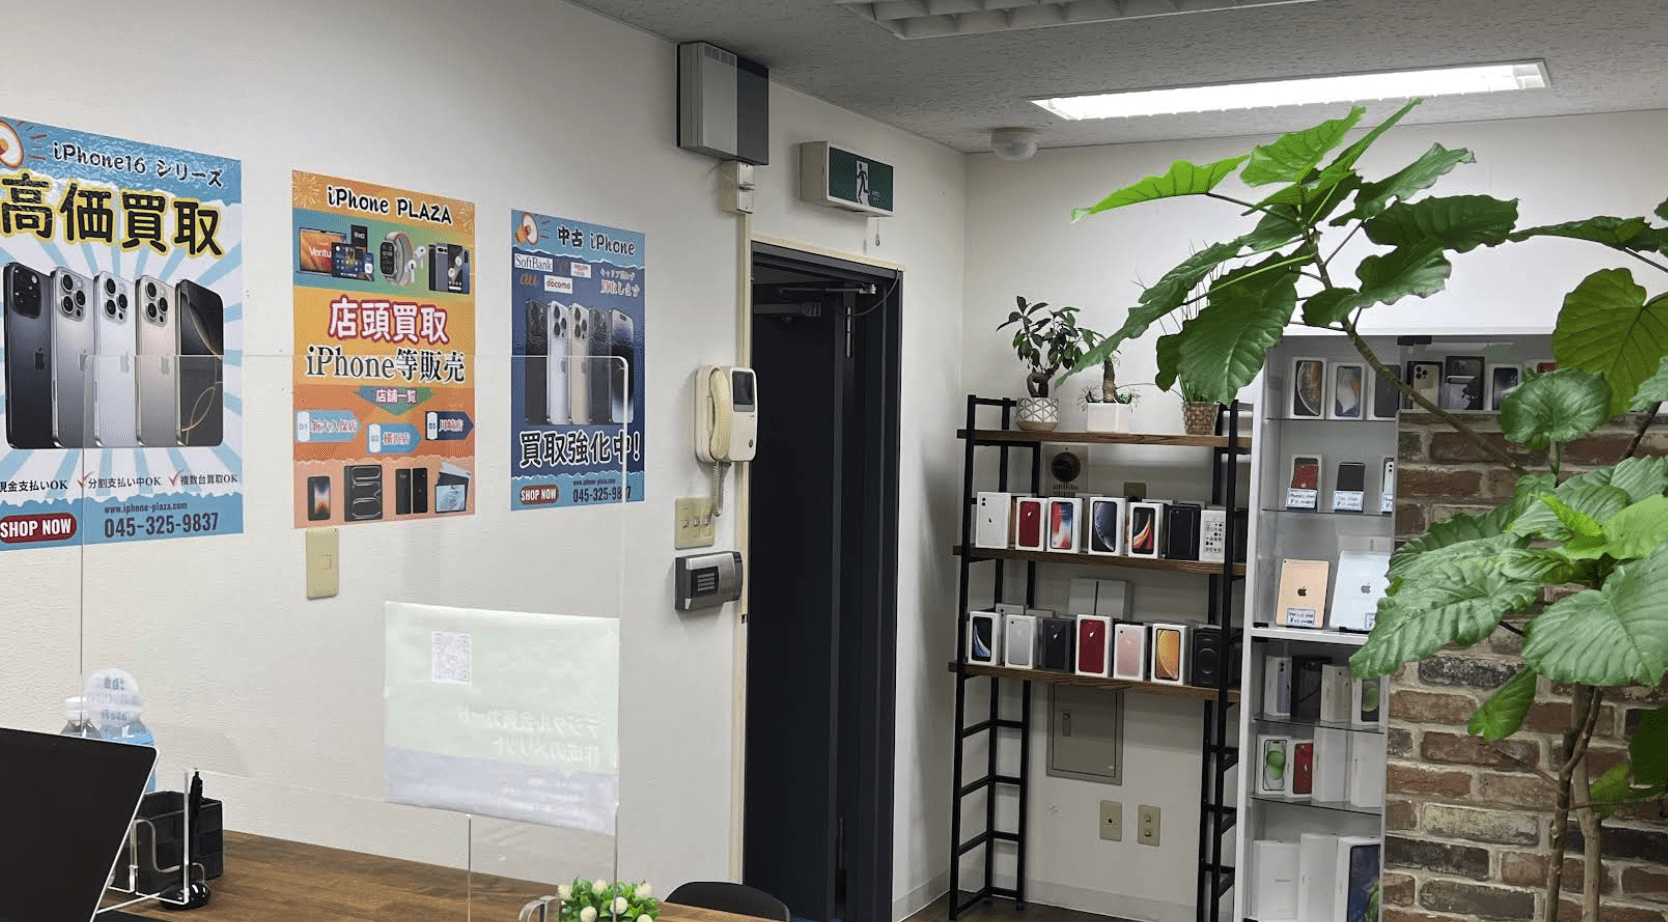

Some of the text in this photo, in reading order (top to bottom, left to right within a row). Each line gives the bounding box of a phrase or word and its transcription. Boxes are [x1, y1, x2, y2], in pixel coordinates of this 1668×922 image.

[53, 142, 224, 187] iPhone16 シリーズ
[1, 172, 223, 256] 高価買取
[328, 186, 452, 224] iPhone PLAZA
[557, 225, 636, 256] 中古 iPhone
[515, 255, 553, 271] SoftBank
[546, 280, 571, 290] docomo
[328, 295, 449, 345] 店頭買取
[306, 345, 465, 382] iPhone等販売
[375, 389, 417, 403] 店舗一覧
[520, 429, 640, 468] 買取強化中!
[0, 480, 68, 493] 現金支払いOK
[88, 476, 162, 489] 分割支払い中OK
[180, 474, 238, 485] 複数台買取OK
[521, 488, 557, 502] SHOP NOW
[573, 485, 632, 503] 045-325-987
[0, 518, 71, 538] SHOP NOW
[104, 512, 219, 538] 045-325-9837
